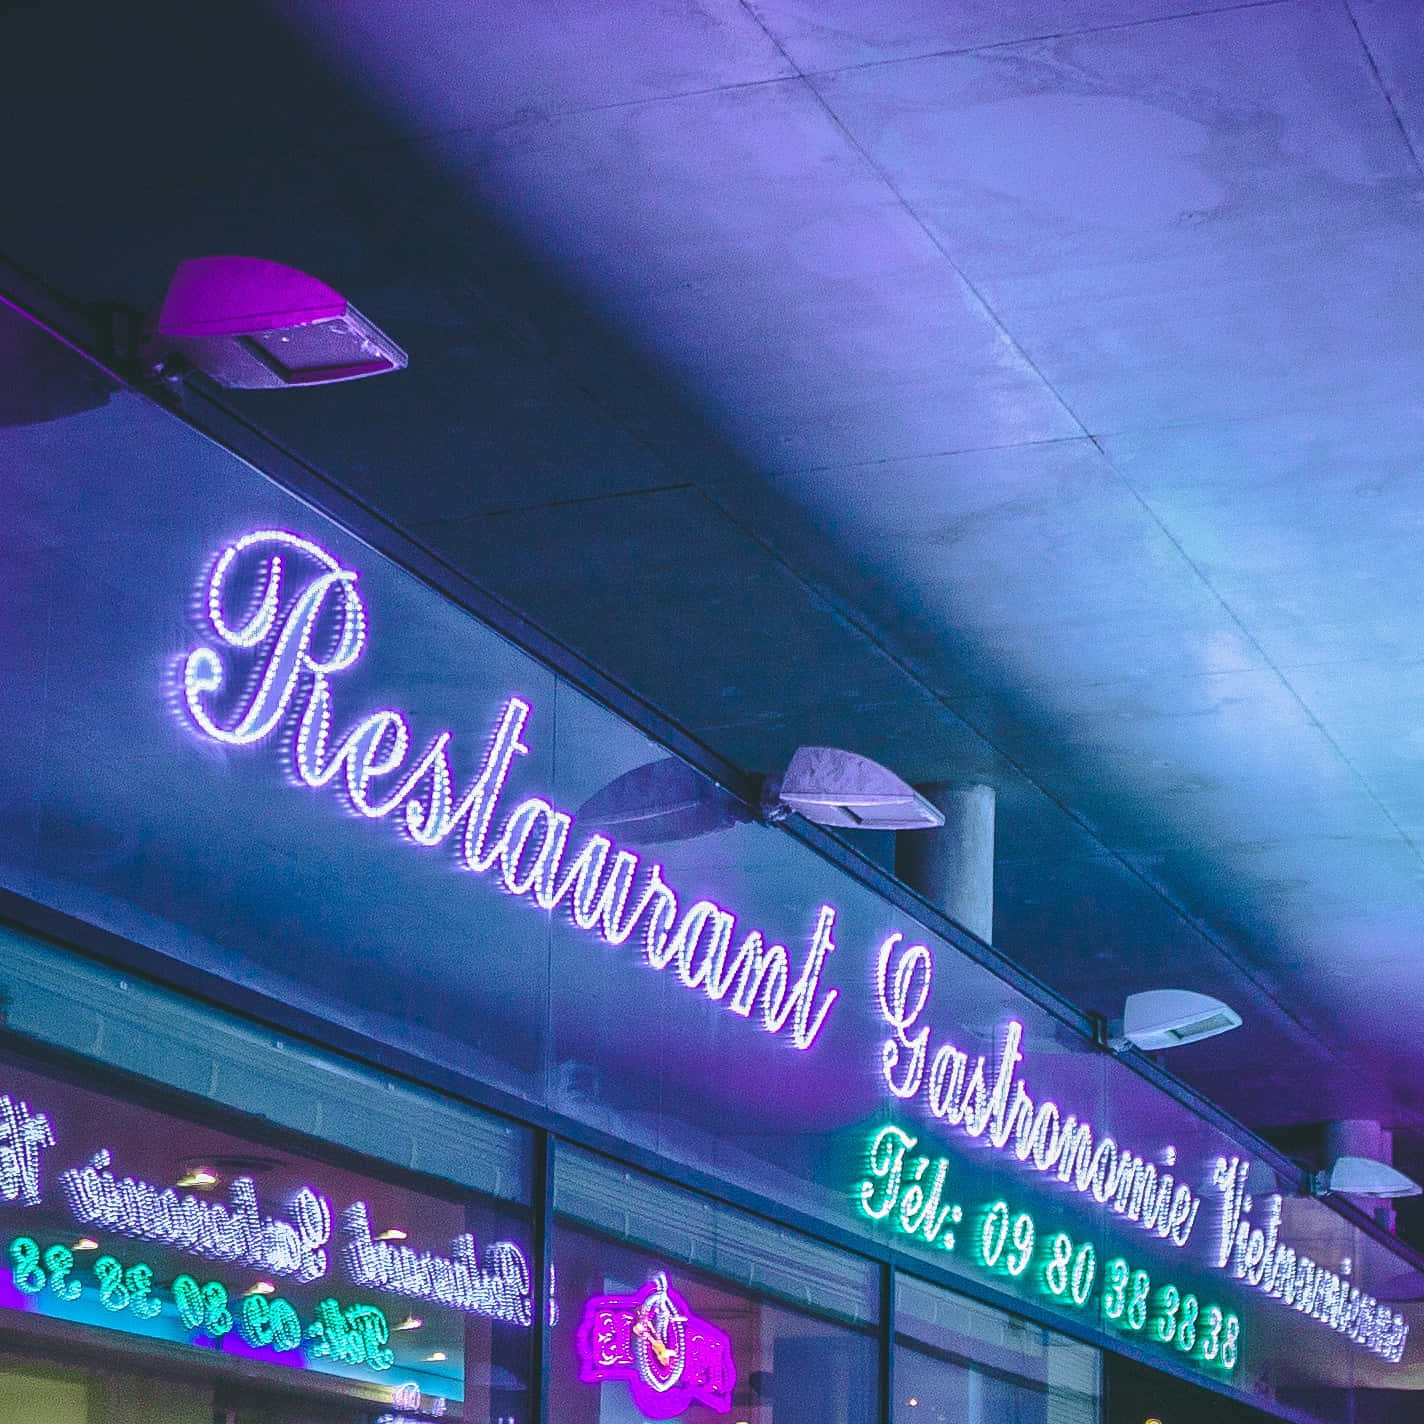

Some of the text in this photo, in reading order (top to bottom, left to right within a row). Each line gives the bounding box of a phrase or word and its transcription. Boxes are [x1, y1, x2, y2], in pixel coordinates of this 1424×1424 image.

[176, 528, 839, 1051] Restaurant
[875, 930, 1200, 1248] Gastronomie
[981, 1200, 1036, 1277] 09
[1047, 1233, 1096, 1305] 80
[1105, 1258, 1149, 1331] 38
[1157, 1283, 1199, 1352] 38
[1203, 1305, 1241, 1370] 38
